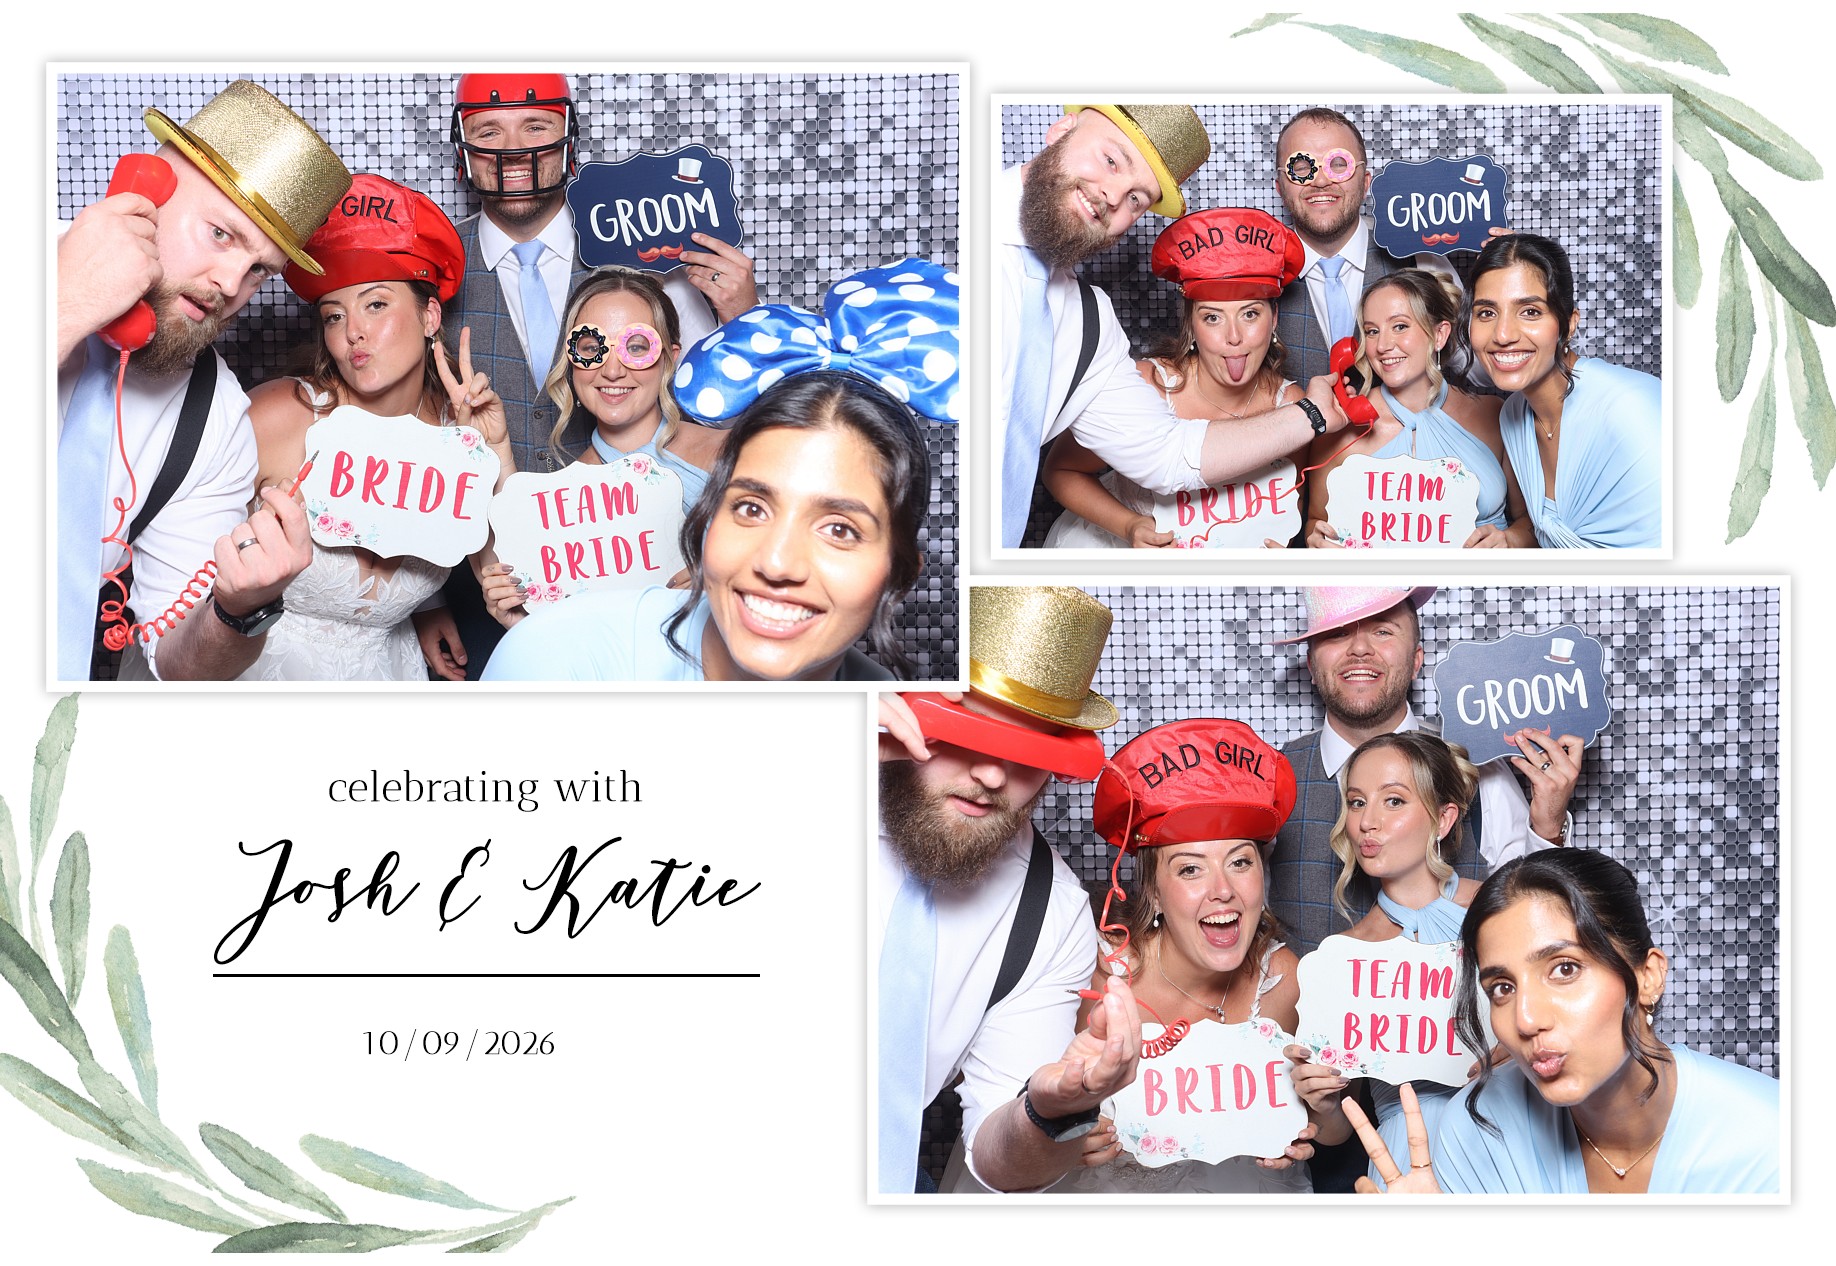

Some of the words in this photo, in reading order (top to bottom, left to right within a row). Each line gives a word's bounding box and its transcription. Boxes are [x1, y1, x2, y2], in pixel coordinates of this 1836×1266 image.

[341, 196, 398, 224] GIRL
[589, 187, 720, 247] GROOM
[1387, 188, 1491, 232] GROOM
[1177, 226, 1224, 261] BAD
[1235, 225, 1278, 254] GIRL
[329, 450, 479, 521] BRIDE
[531, 481, 639, 530] TEAM
[1176, 477, 1287, 527] BRIDE
[1364, 471, 1446, 503] TEAM
[1361, 511, 1452, 544] BRIDE
[540, 529, 661, 584] BRIDE
[1456, 667, 1589, 731] GROOM
[1138, 743, 1201, 789] BAD
[1214, 741, 1267, 780] GIRL
[1347, 958, 1457, 1001] TEAM
[1143, 1060, 1288, 1117] BRIDE
